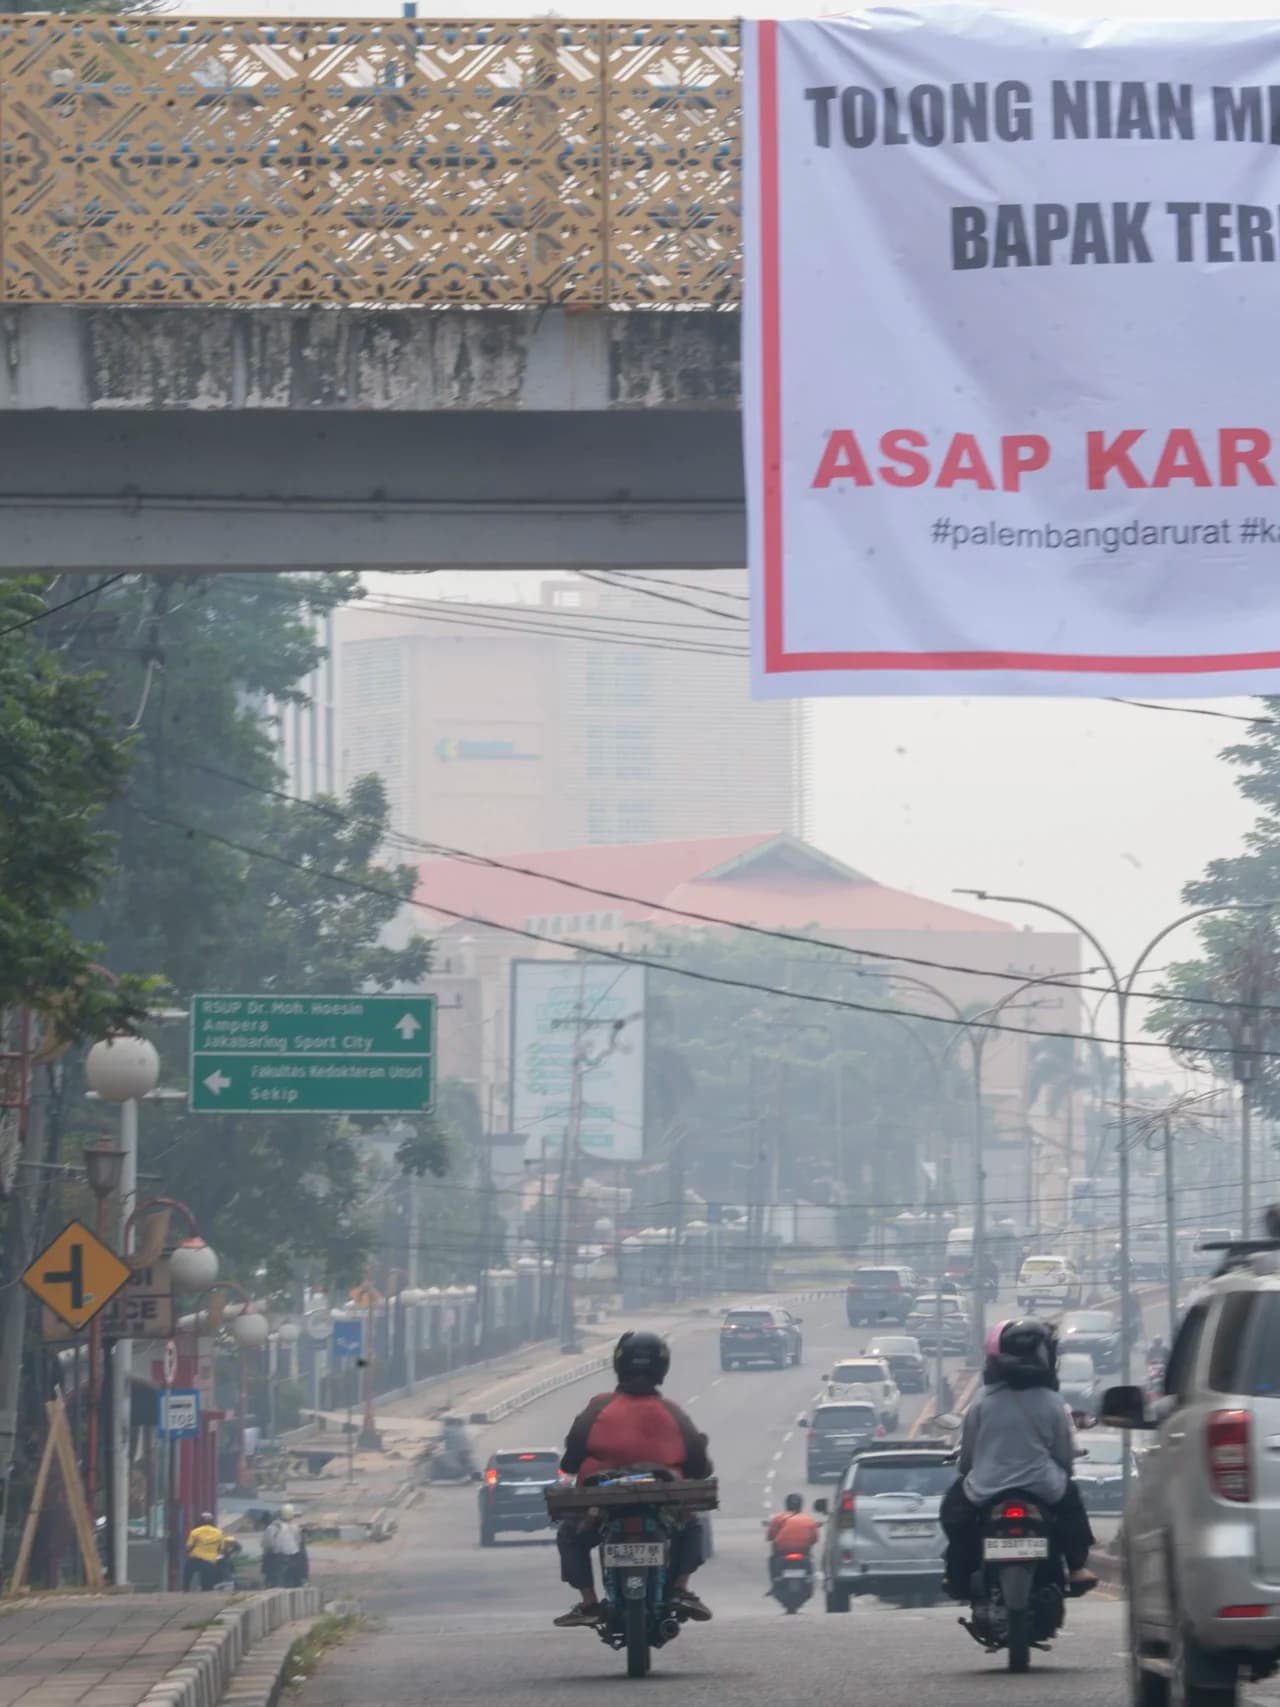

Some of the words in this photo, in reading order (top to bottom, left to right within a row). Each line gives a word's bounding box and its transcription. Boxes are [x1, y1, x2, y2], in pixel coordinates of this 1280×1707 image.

[805, 80, 1033, 148] TOLONG
[1050, 80, 1195, 140] NIAN
[950, 201, 1153, 270] BAPAK
[810, 428, 1051, 493] ASAP
[931, 518, 1233, 552] #palembangdarurat
[203, 1001, 242, 1015] RSUP
[310, 1001, 364, 1015] Hoesin
[203, 1019, 269, 1035] Ampera
[203, 1035, 288, 1052] Jakabaring
[295, 1035, 337, 1052] Sport
[341, 1035, 374, 1053] City
[250, 1065, 306, 1078] Fakultas
[250, 1087, 298, 1103] Sekip
